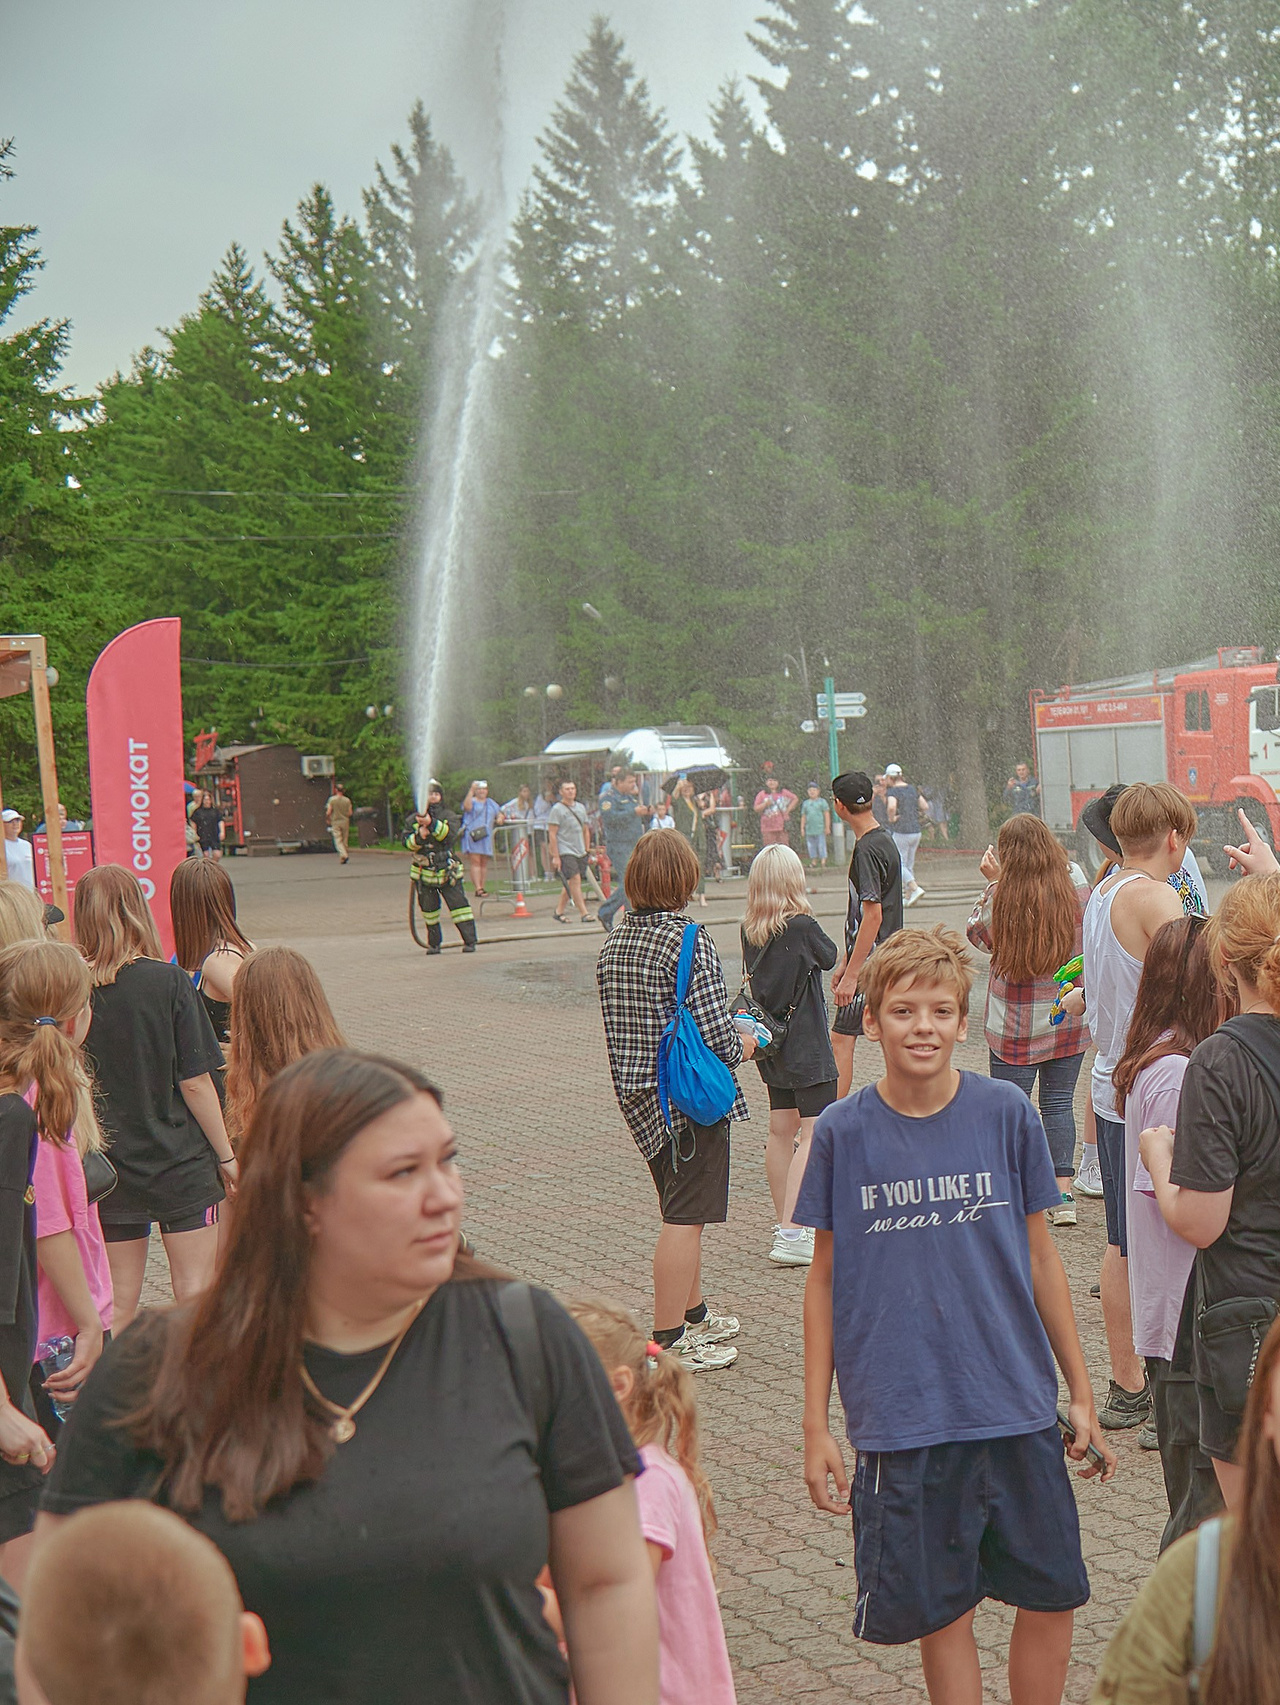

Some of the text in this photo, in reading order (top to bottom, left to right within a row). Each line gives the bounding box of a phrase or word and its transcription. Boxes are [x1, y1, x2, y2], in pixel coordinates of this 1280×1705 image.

[1262, 743, 1268, 759] 1
[860, 1172, 992, 1210] IF YOU LIKE IT
[865, 1196, 1009, 1234] wear it
